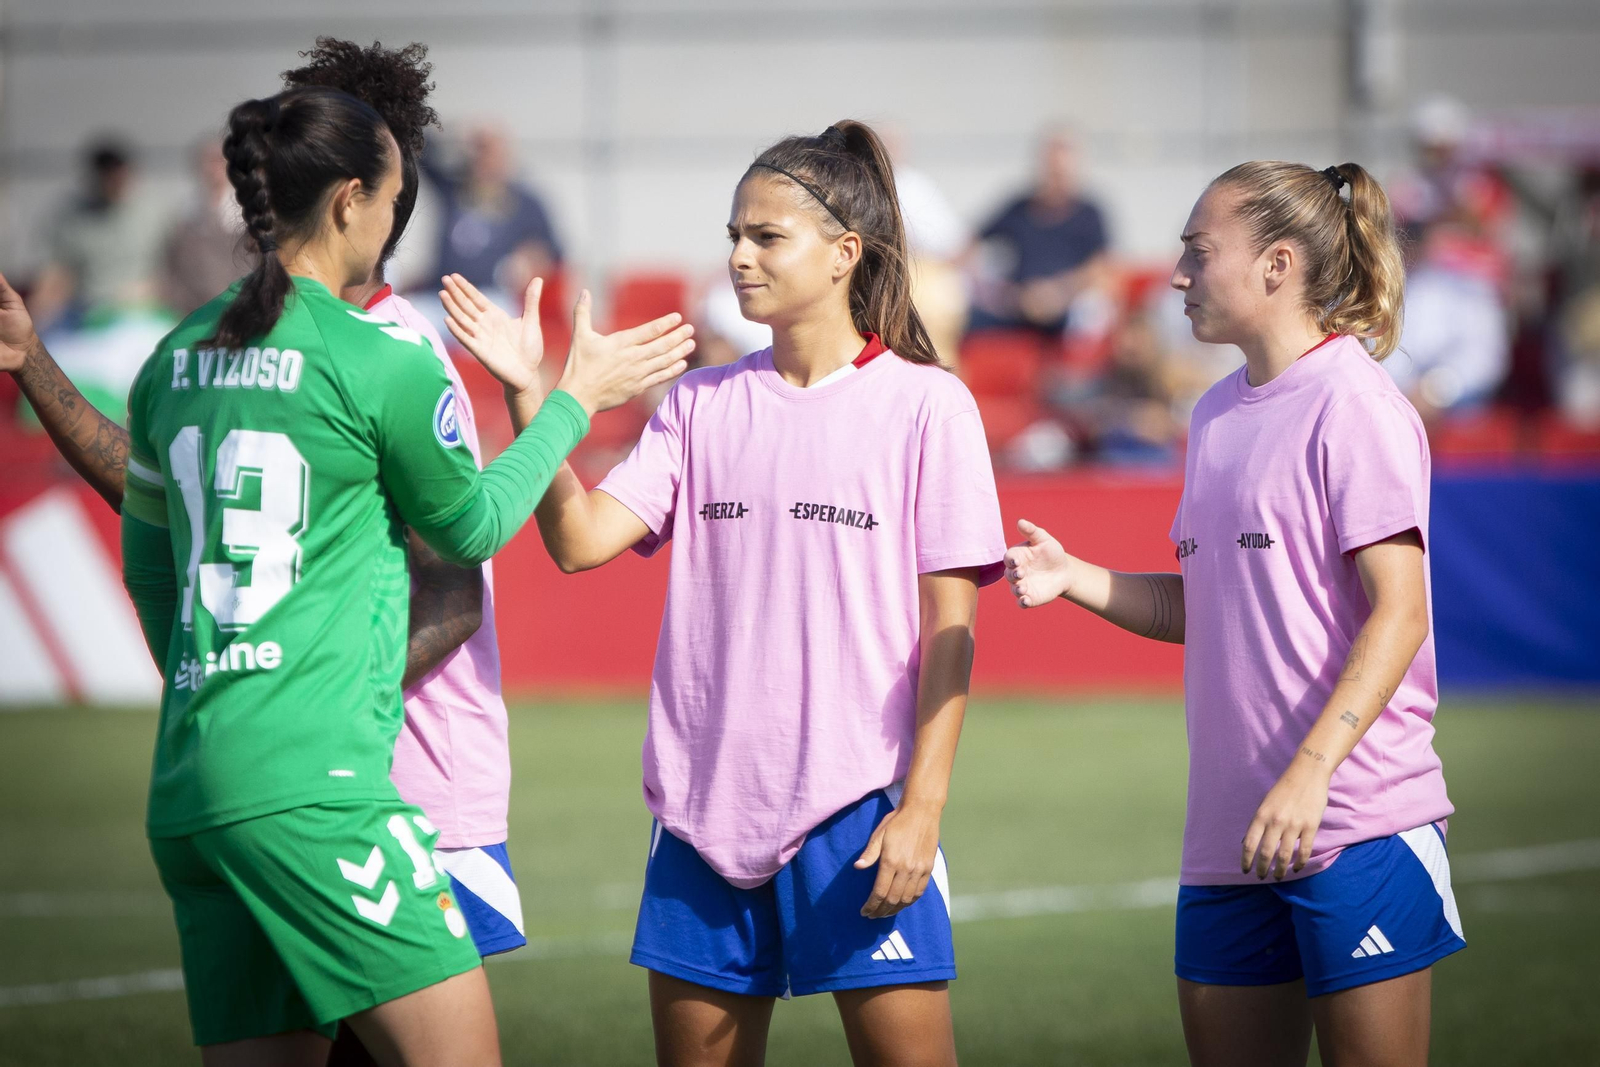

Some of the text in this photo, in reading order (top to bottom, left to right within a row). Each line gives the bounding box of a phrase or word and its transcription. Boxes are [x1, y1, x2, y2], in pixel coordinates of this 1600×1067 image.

[171, 346, 304, 393] P. VIZOSO
[169, 426, 310, 632] 13
[699, 502, 879, 531] FUERZA ESPERANZA
[1236, 532, 1275, 549] AYUDA
